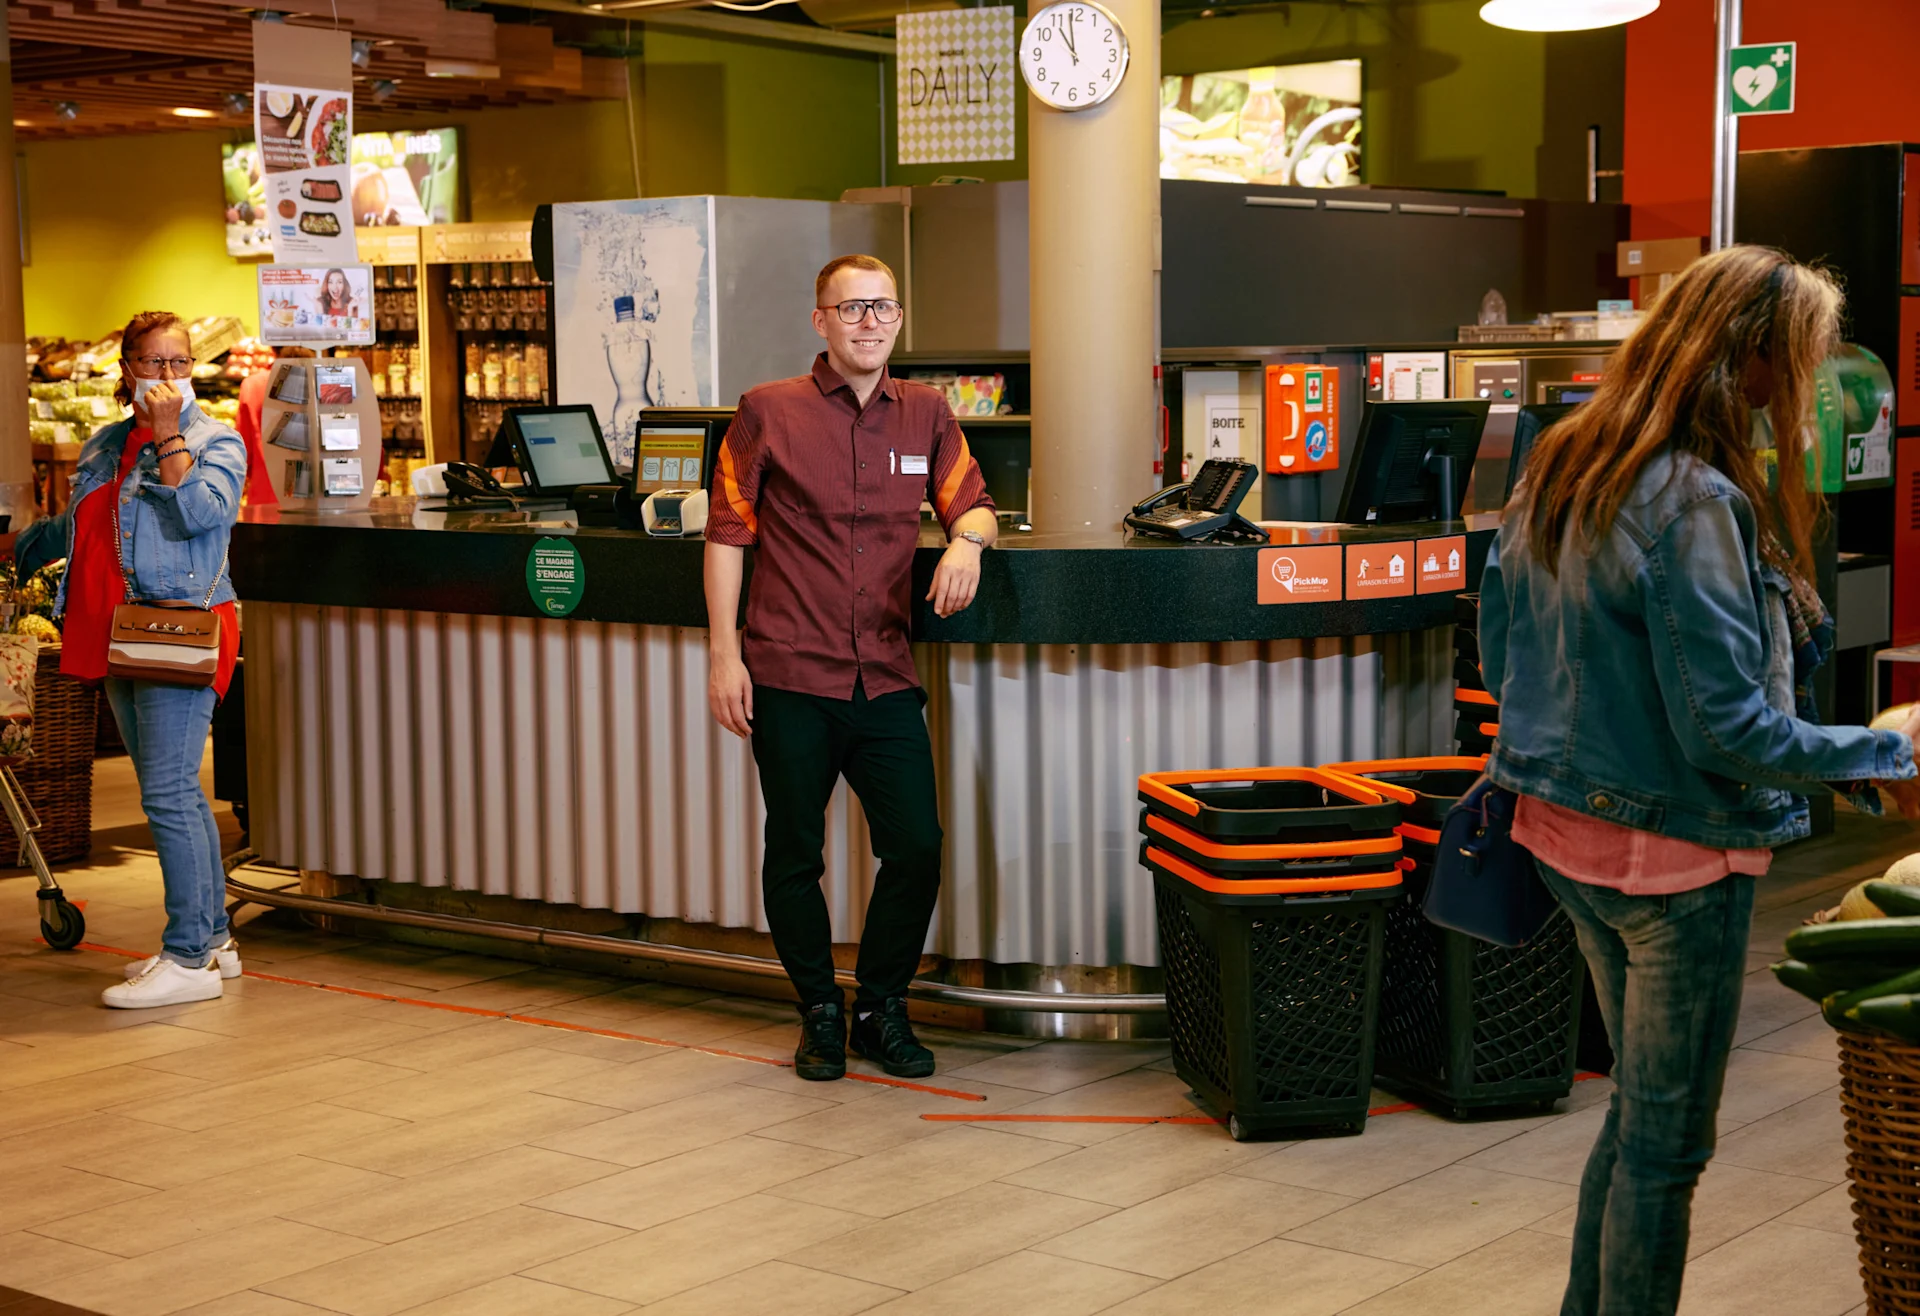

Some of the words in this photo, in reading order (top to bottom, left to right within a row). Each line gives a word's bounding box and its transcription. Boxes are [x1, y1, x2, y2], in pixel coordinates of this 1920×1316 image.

[1050, 13, 1063, 27] 11
[1068, 8, 1084, 22] 12
[1091, 13, 1097, 27] 1
[1036, 27, 1052, 42] 10
[1103, 28, 1113, 43] 2
[1033, 47, 1042, 62] 9
[1108, 48, 1117, 63] 3
[1037, 67, 1046, 82] 8
[1101, 68, 1112, 82] 4
[910, 62, 997, 107] DAILY
[1050, 82, 1060, 96] 7
[1087, 82, 1097, 97] 5
[1068, 87, 1077, 102] 6
[1212, 418, 1245, 429] BOITE
[535, 557, 545, 565] CE
[545, 557, 575, 566] MAGASIN
[536, 569, 575, 579] S'ENGAGE
[1293, 577, 1329, 586] PickMup
[1357, 579, 1382, 587] LIVRAISON
